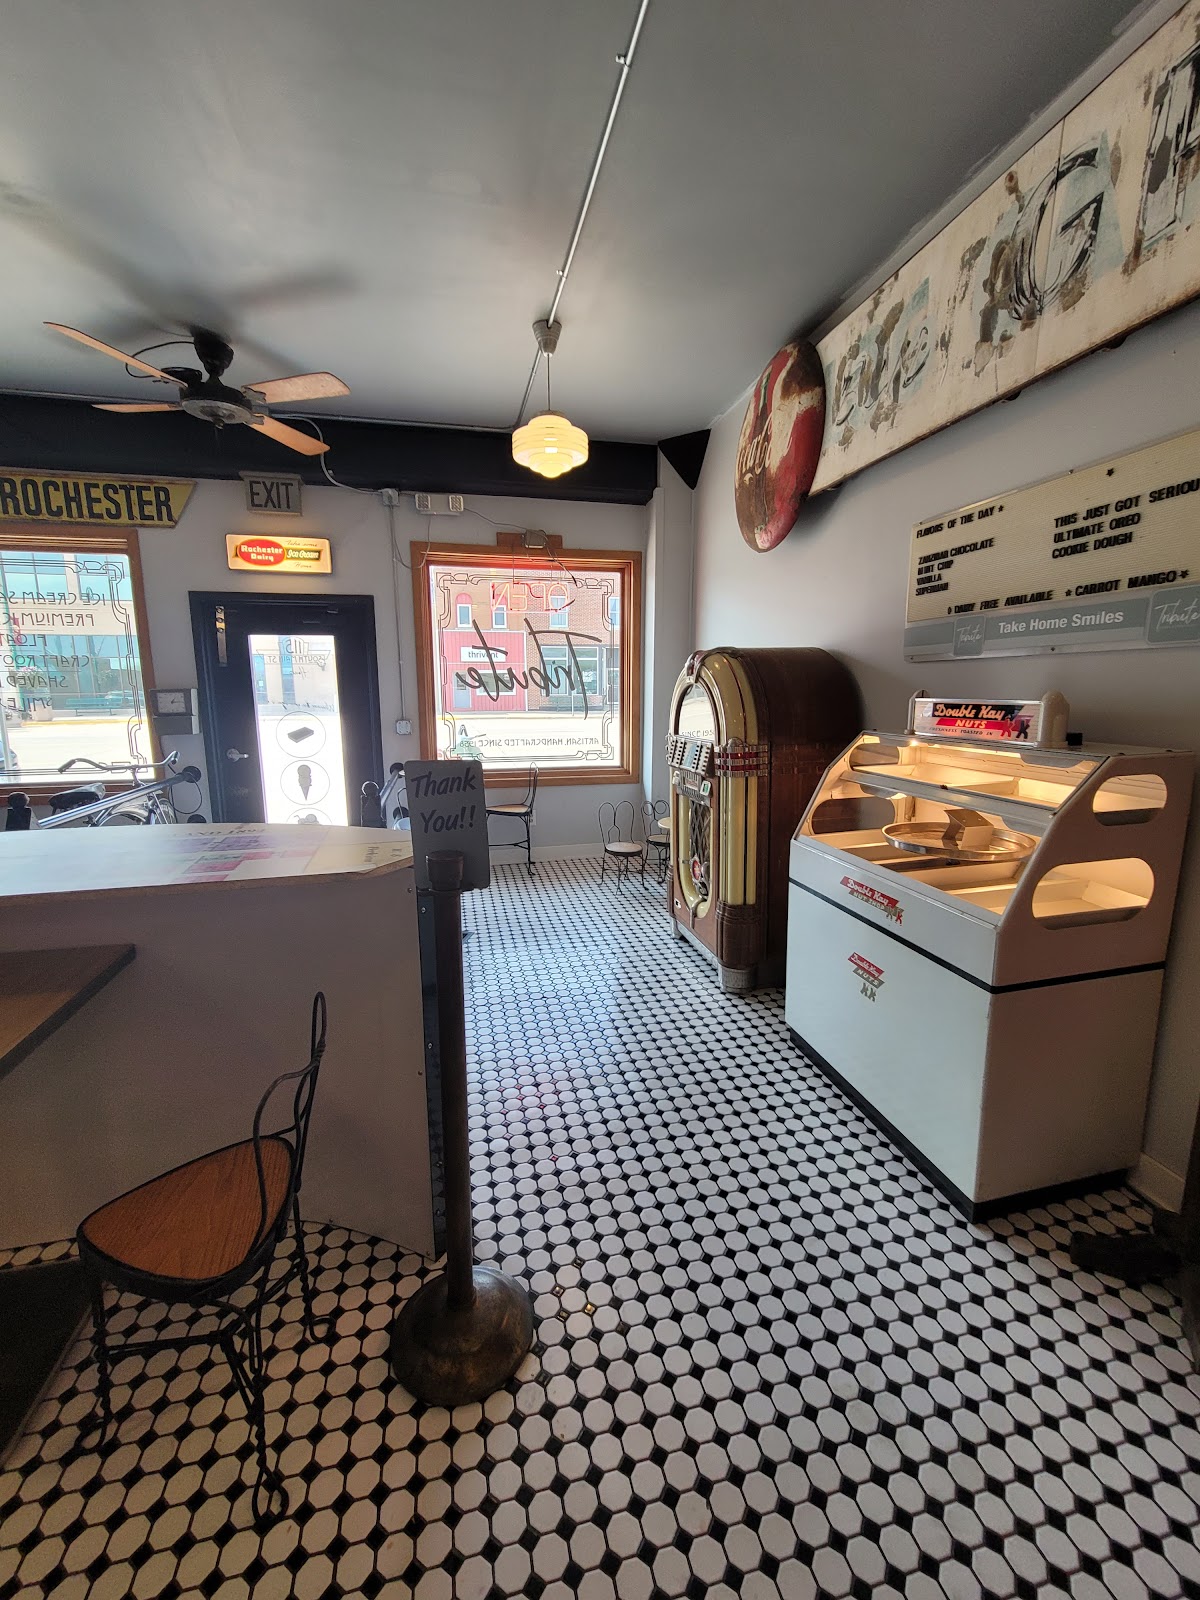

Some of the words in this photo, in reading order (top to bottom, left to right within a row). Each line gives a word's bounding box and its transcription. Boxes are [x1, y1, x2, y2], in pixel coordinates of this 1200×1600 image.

[0, 477, 175, 521] ROCHESTER
[249, 480, 293, 509] EXIT
[916, 523, 943, 538] FLAVORS
[947, 518, 957, 529] OF
[960, 512, 974, 524] THE
[978, 505, 995, 519] DAY
[1054, 513, 1077, 528] THIS
[1082, 503, 1110, 520] JUST
[1114, 495, 1140, 512] GOT
[1053, 521, 1104, 543] ULTIMATE
[1109, 512, 1141, 530] OREO
[240, 544, 283, 554] Rochester
[950, 537, 994, 557] CHOCOLATE
[1052, 541, 1089, 559] COOKIE
[1093, 531, 1133, 551] DOUGH
[250, 553, 275, 562] Dairy
[915, 582, 948, 596] SUPERMAN
[917, 573, 942, 585] VANILLA
[1075, 580, 1121, 596] CARROT
[1127, 570, 1177, 589] MANGO
[954, 603, 976, 614] DAIRY
[980, 599, 1000, 610] FREE
[1004, 590, 1054, 606] AVAILABLE
[999, 621, 1026, 634] Take
[1030, 617, 1068, 630] Home
[1071, 611, 1124, 627] Smiles
[1154, 598, 1200, 632] Tribute
[934, 703, 976, 718] Double
[978, 705, 1006, 720] Kay
[955, 719, 987, 728] NUTS
[410, 766, 477, 798] Thank
[420, 804, 476, 834] You!!
[847, 878, 873, 898] Double
[852, 891, 868, 904] NUT
[868, 899, 885, 911] SHOP
[856, 969, 880, 986] NUTS
